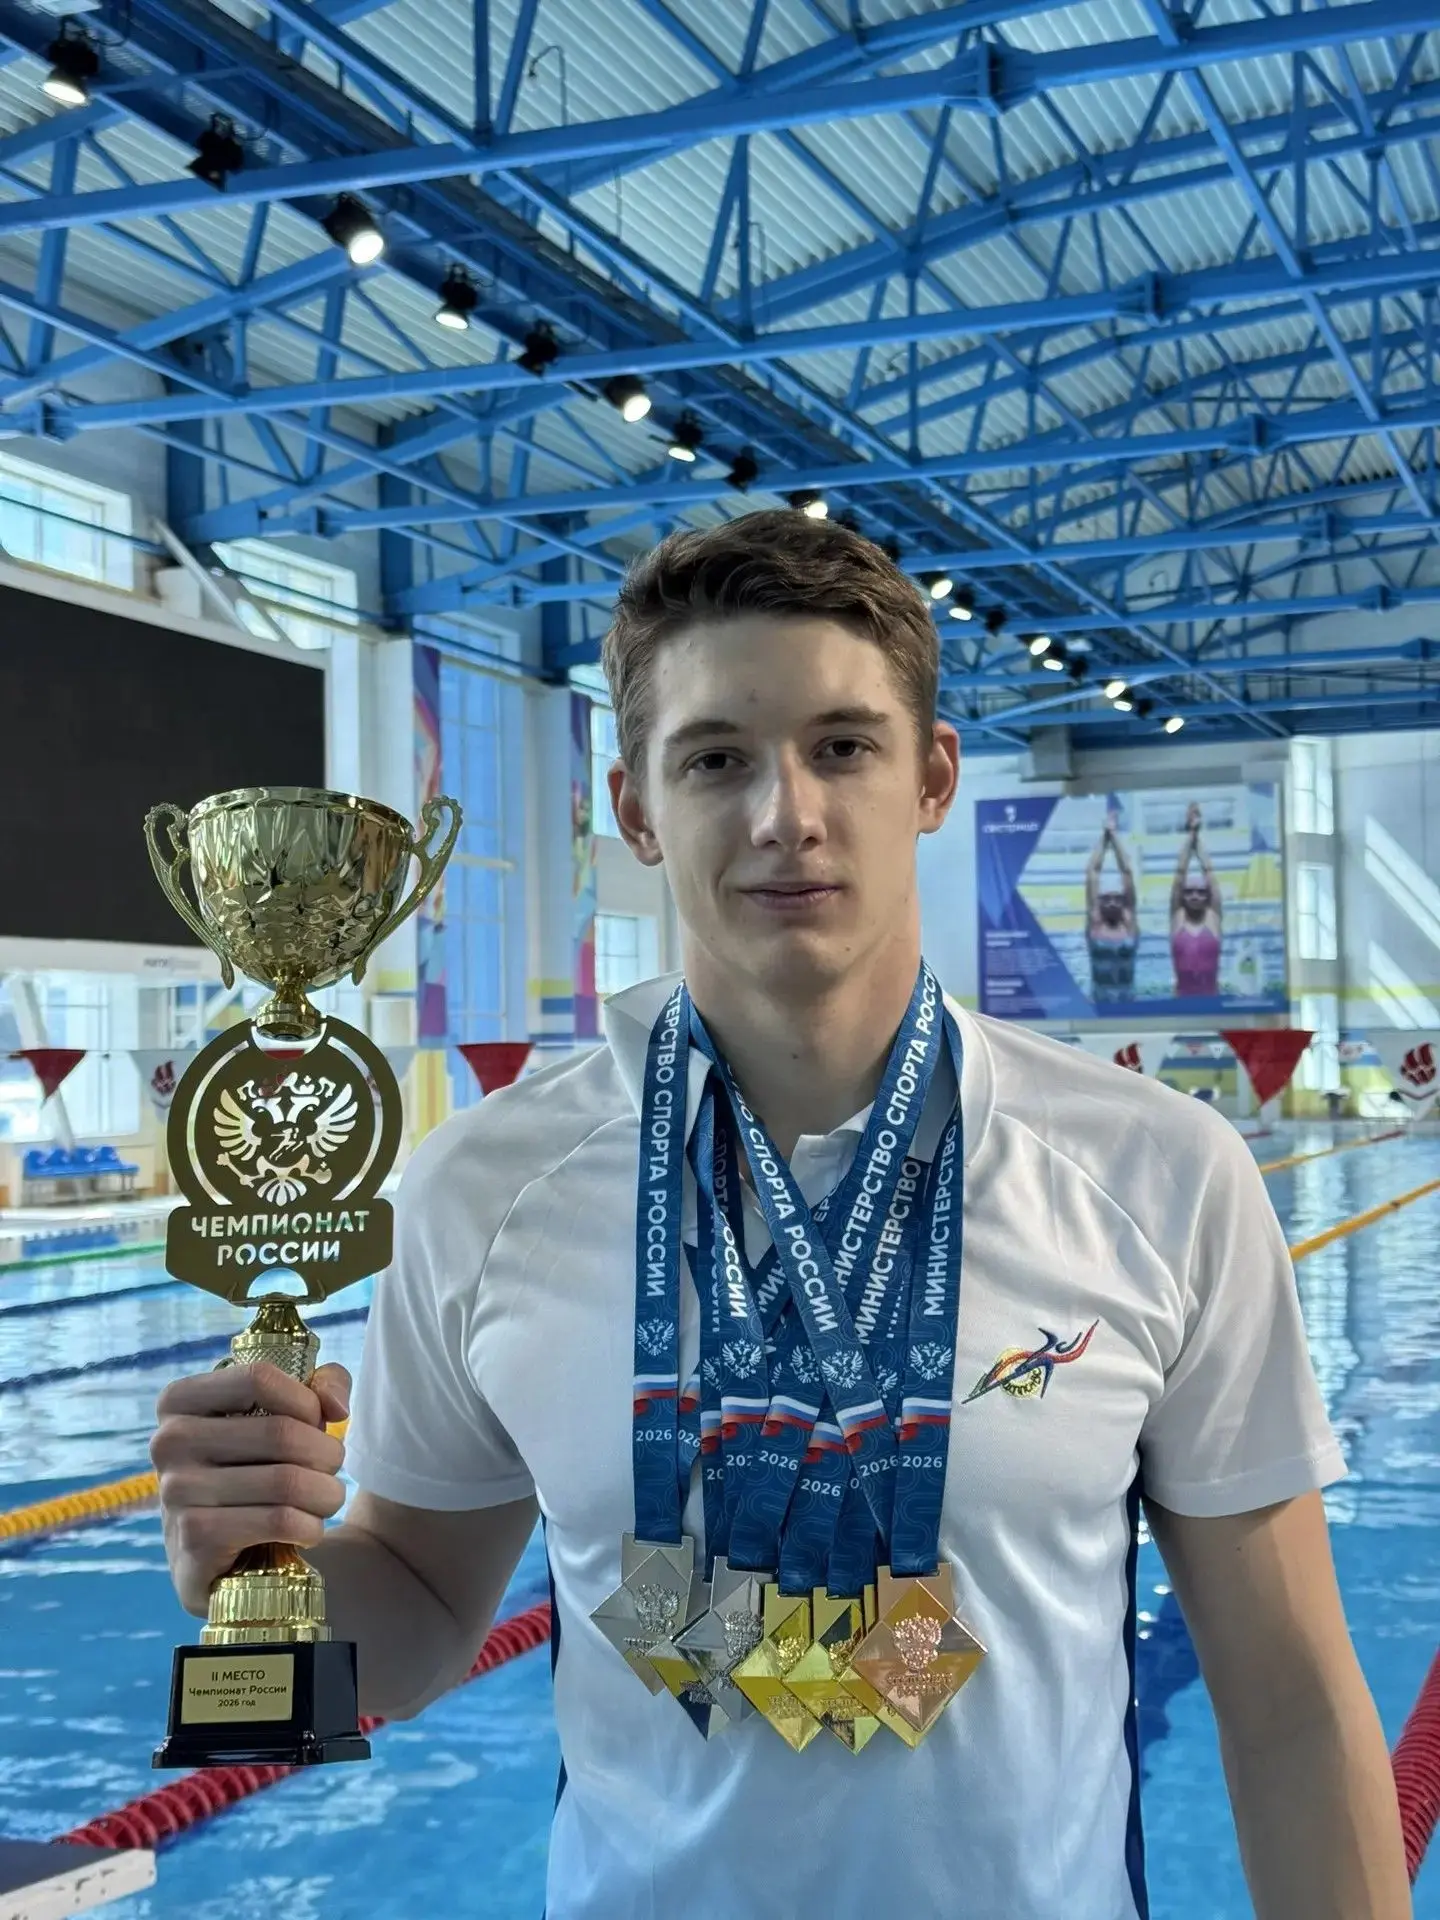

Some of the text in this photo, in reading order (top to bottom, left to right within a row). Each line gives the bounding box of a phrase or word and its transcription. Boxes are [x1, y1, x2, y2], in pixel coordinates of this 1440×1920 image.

[649, 1091, 673, 1182] СПОРТА
[832, 1129, 898, 1293] НИСТЕРСТВО
[886, 1039, 929, 1126] СПОРТА
[191, 1210, 370, 1238] ЧЕМПИОНАТ
[749, 1127, 796, 1220] СПОРТА
[784, 1224, 839, 1333] РОССИИ
[924, 1124, 956, 1316] МИНИСТЕРСТВО
[216, 1240, 341, 1267] РОССИИ
[647, 1190, 667, 1297] РОССИИ
[854, 1160, 922, 1345] МИНИСТЕРСТВО
[635, 1428, 673, 1442] 2026
[678, 1429, 701, 1448] 026
[758, 1450, 799, 1471] 2026
[859, 1454, 899, 1477] 2026
[902, 1455, 943, 1468] 2026
[800, 1478, 841, 1497] 2026
[222, 1669, 266, 1681] МЕСТО
[188, 1684, 287, 1696] Чемпионат России
[217, 1699, 256, 1707] 2026 год
